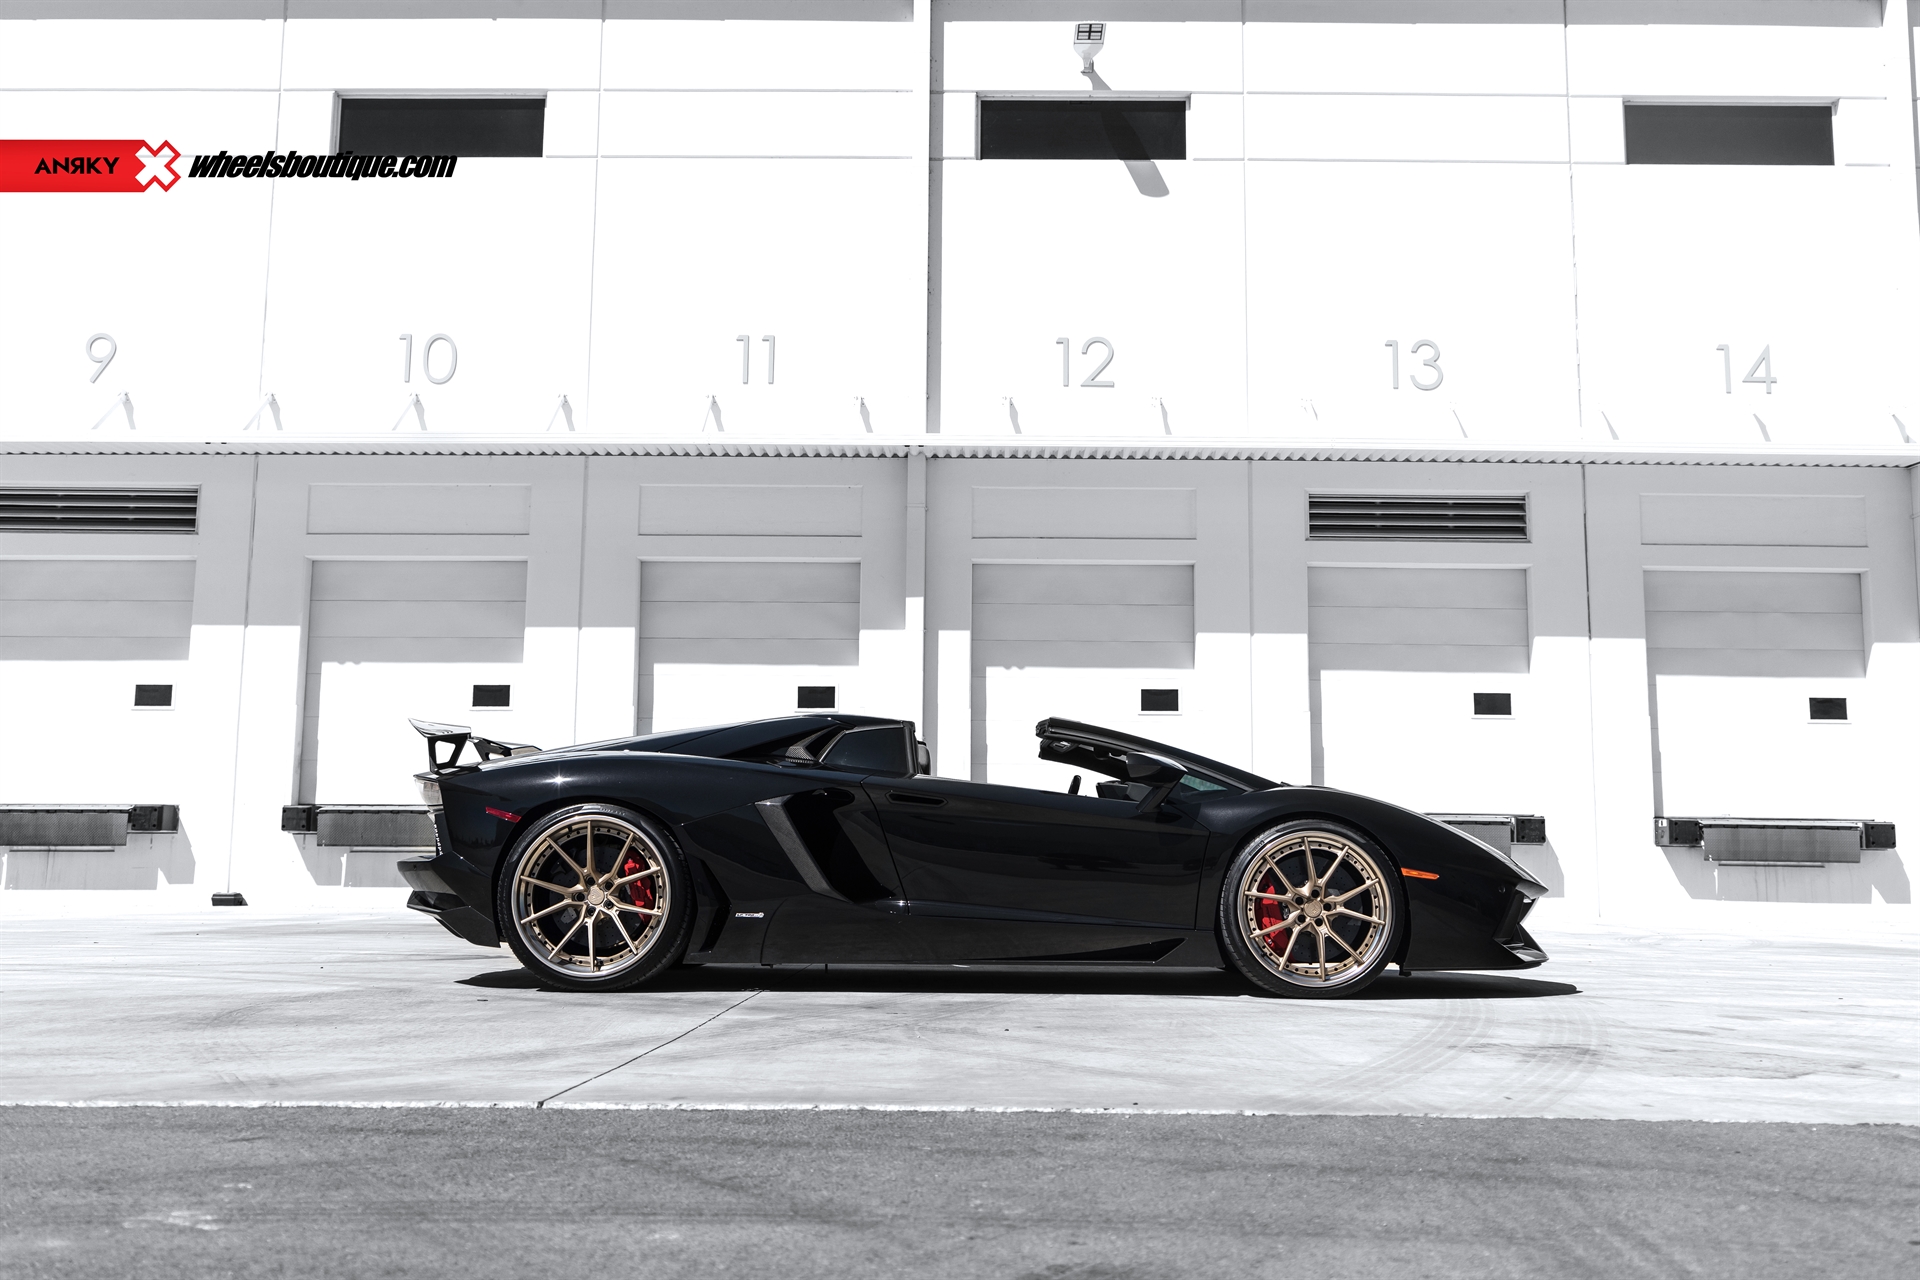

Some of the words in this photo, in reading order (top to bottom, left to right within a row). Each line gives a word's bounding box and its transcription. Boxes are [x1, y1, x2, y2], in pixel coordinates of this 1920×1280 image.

[86, 332, 118, 385] 9
[398, 333, 458, 385] 10
[735, 334, 776, 386] 11
[1055, 336, 1116, 389] 12
[1384, 339, 1444, 392] 13
[1715, 344, 1777, 395] 14
